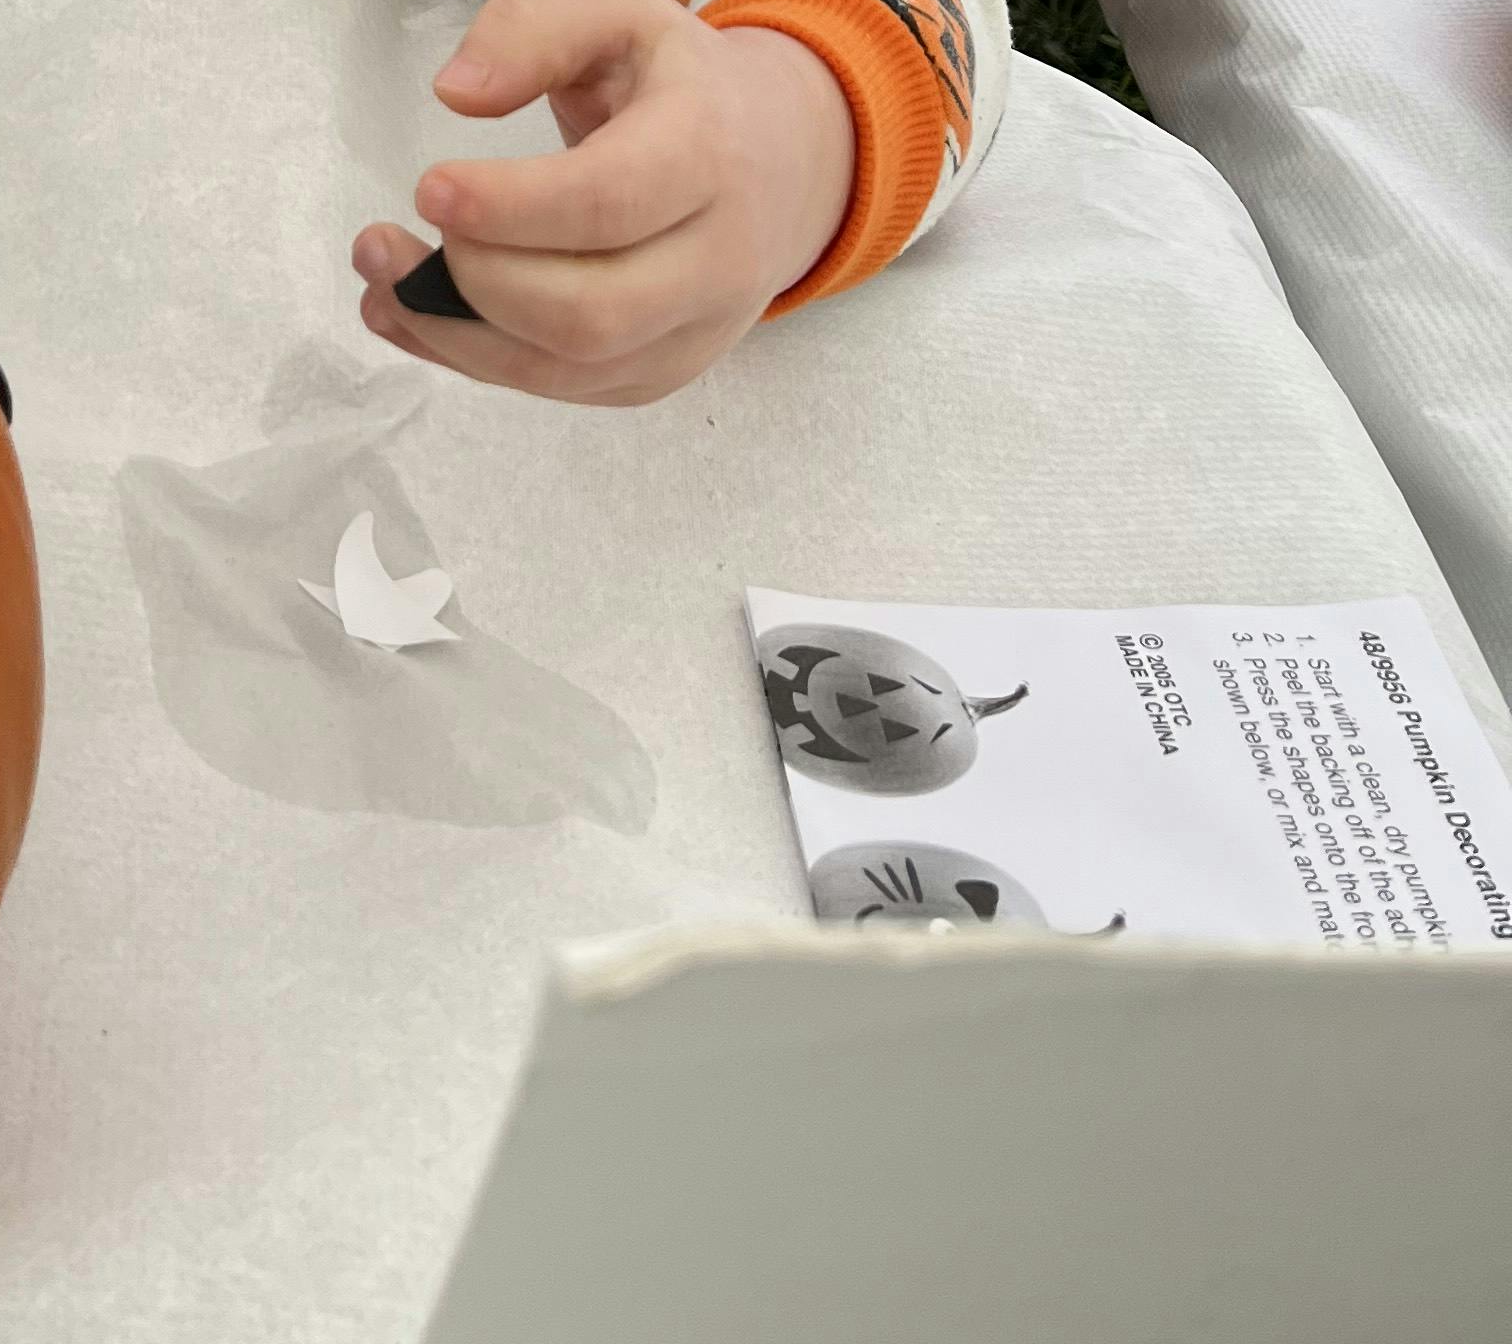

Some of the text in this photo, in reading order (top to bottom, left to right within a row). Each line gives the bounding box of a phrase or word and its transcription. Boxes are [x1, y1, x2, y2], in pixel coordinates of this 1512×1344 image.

[1262, 632, 1285, 647] 2.
[1295, 634, 1317, 647] 1.
[1139, 633, 1192, 727] © 2005 OTC
[1212, 659, 1251, 714] shown
[1275, 658, 1312, 695] Peel
[1308, 658, 1343, 698] Start
[1114, 634, 1180, 756] MADE IN CHINA
[1295, 700, 1321, 729] the
[1329, 702, 1361, 738] with
[1232, 631, 1253, 647] 3.
[1243, 657, 1279, 706] Press
[1268, 711, 1293, 740] the
[1282, 746, 1326, 817] shapes
[1314, 822, 1346, 866] onto
[1335, 872, 1361, 904] the
[1240, 720, 1276, 781] below,
[1348, 743, 1366, 757] a
[1310, 734, 1355, 808] backing
[1359, 630, 1512, 939] 48/9956 Pumpkin Decorating
[1267, 788, 1290, 809] or
[1356, 761, 1392, 819] clean,
[1276, 814, 1307, 849] mix
[1345, 814, 1376, 839] off
[1383, 825, 1411, 857] dry
[1358, 845, 1386, 864] of
[1294, 855, 1329, 893] and
[1368, 870, 1396, 903] the
